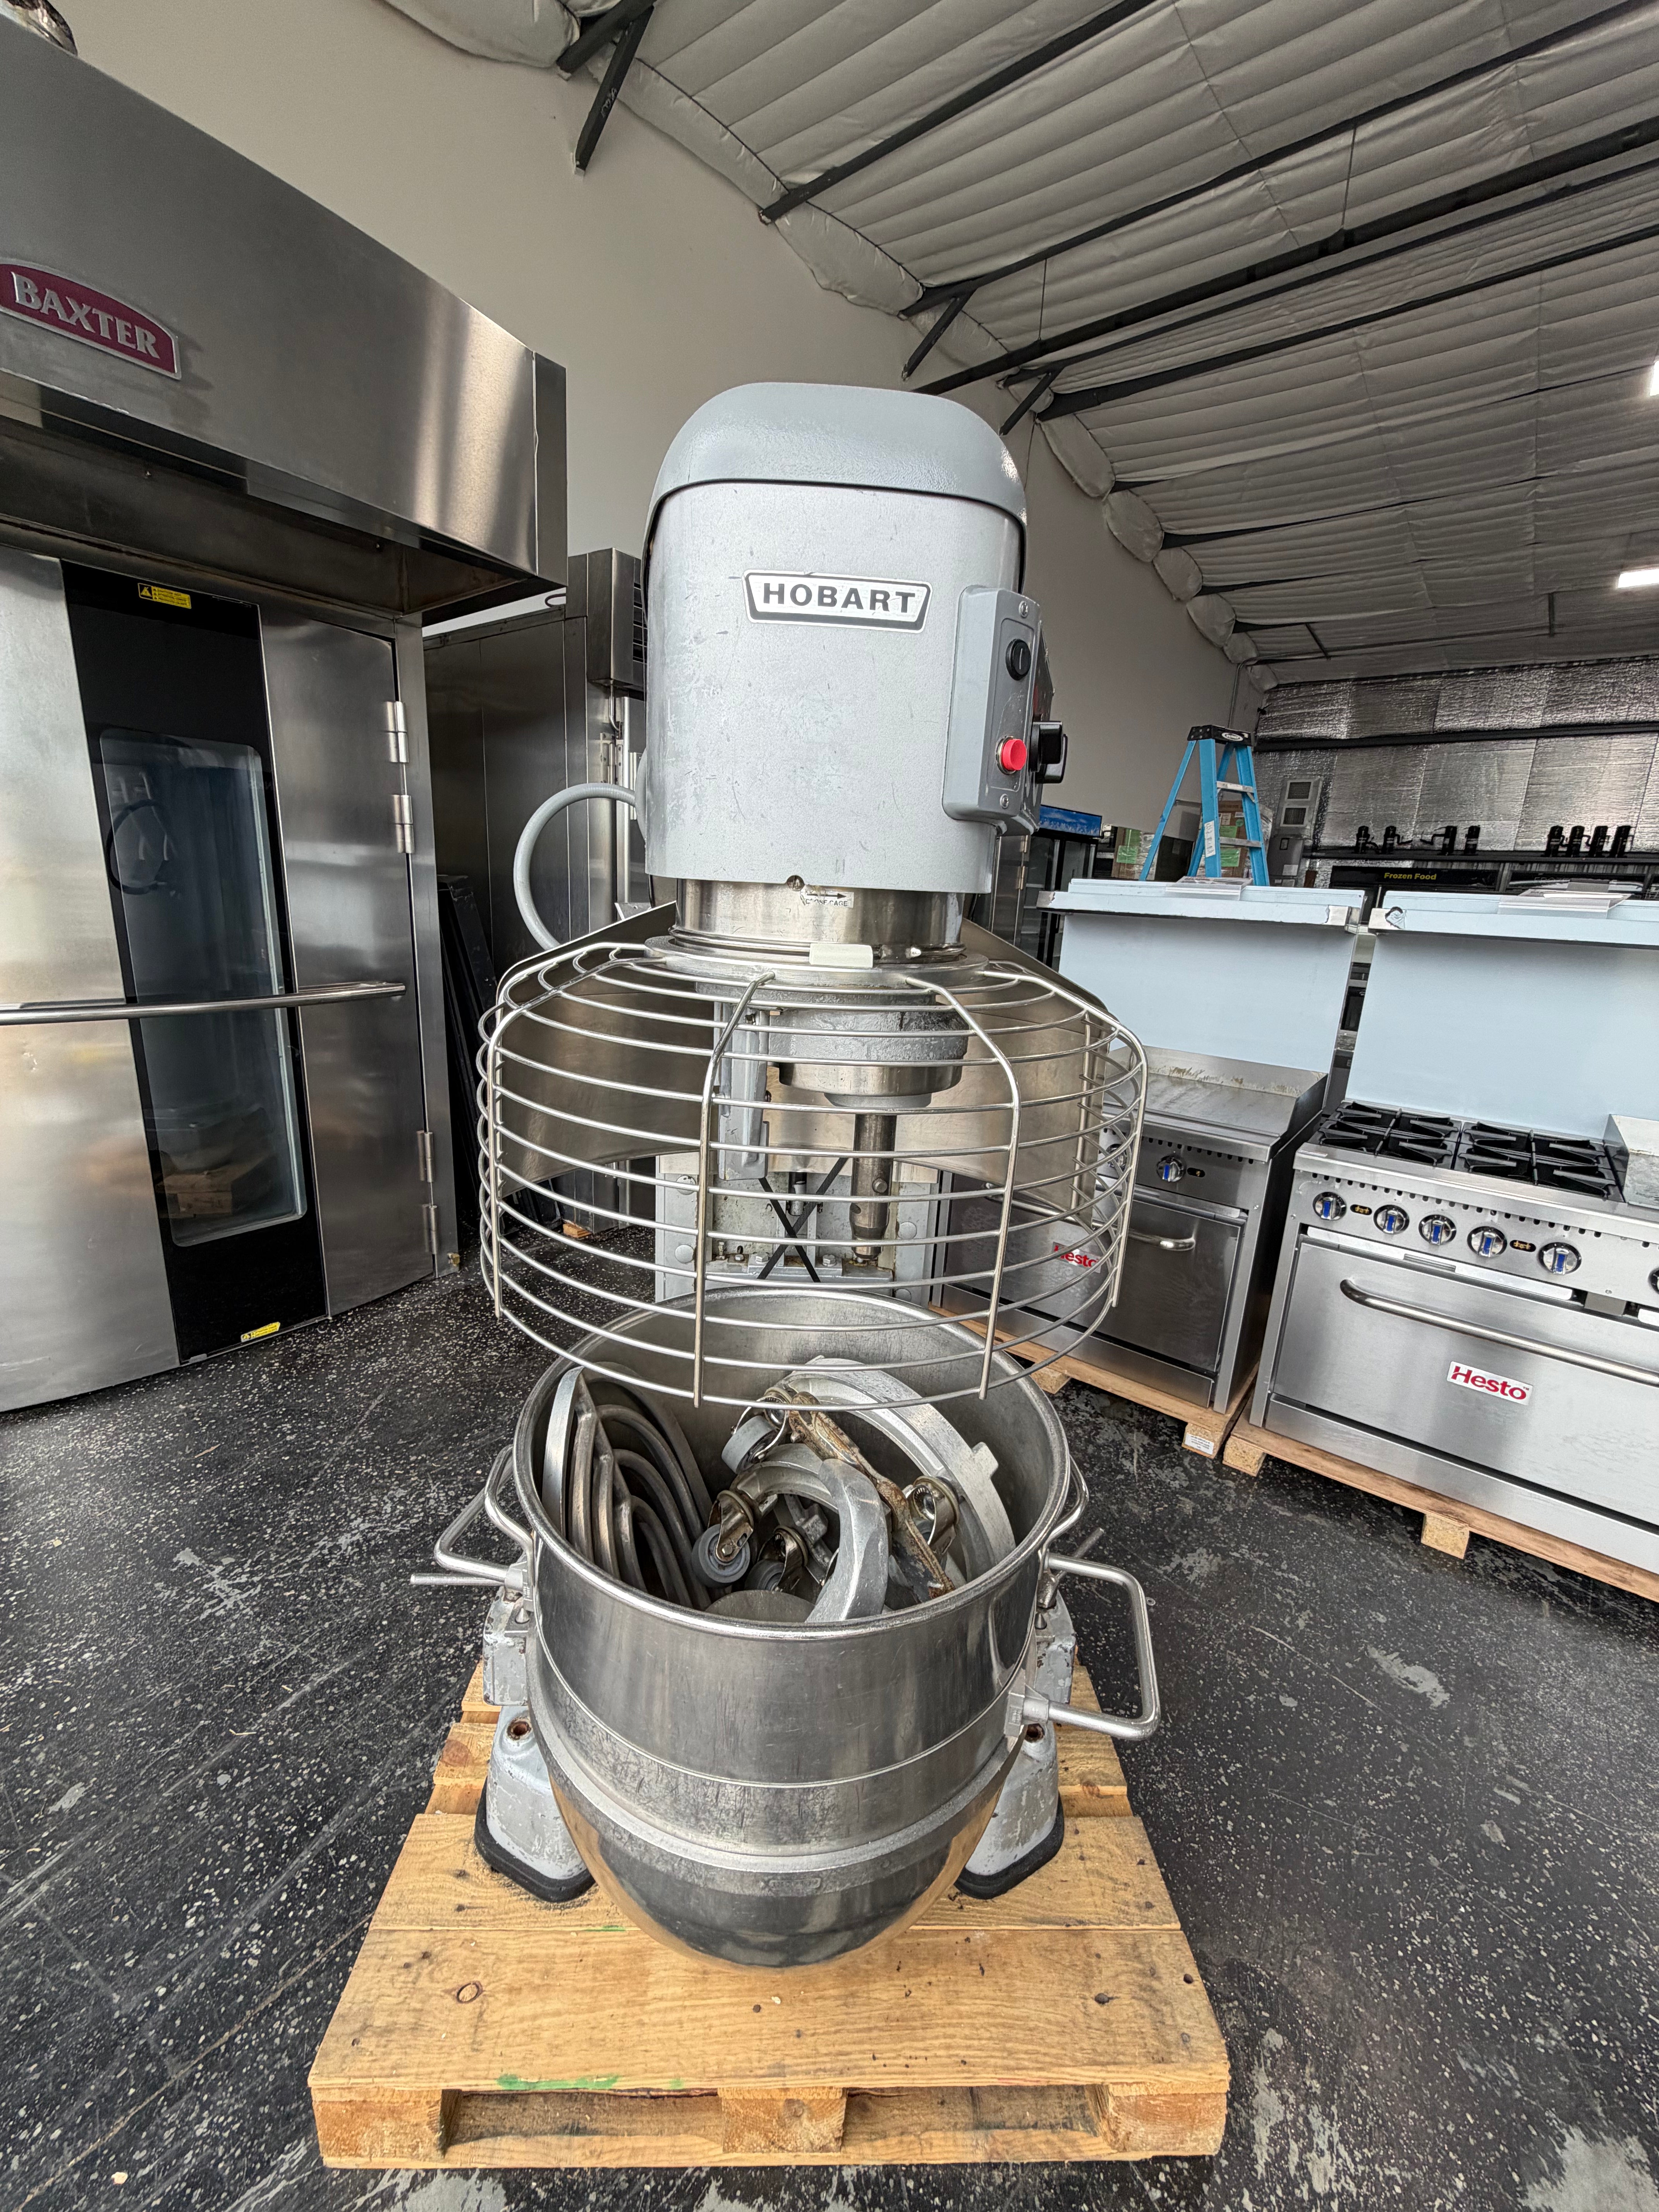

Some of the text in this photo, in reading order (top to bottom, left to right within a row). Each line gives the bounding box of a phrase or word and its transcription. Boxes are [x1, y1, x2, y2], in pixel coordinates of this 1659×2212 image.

[11, 271, 160, 359] BAXTER
[763, 583, 915, 613] HOBART
[1451, 1365, 1527, 1400] Hesto
